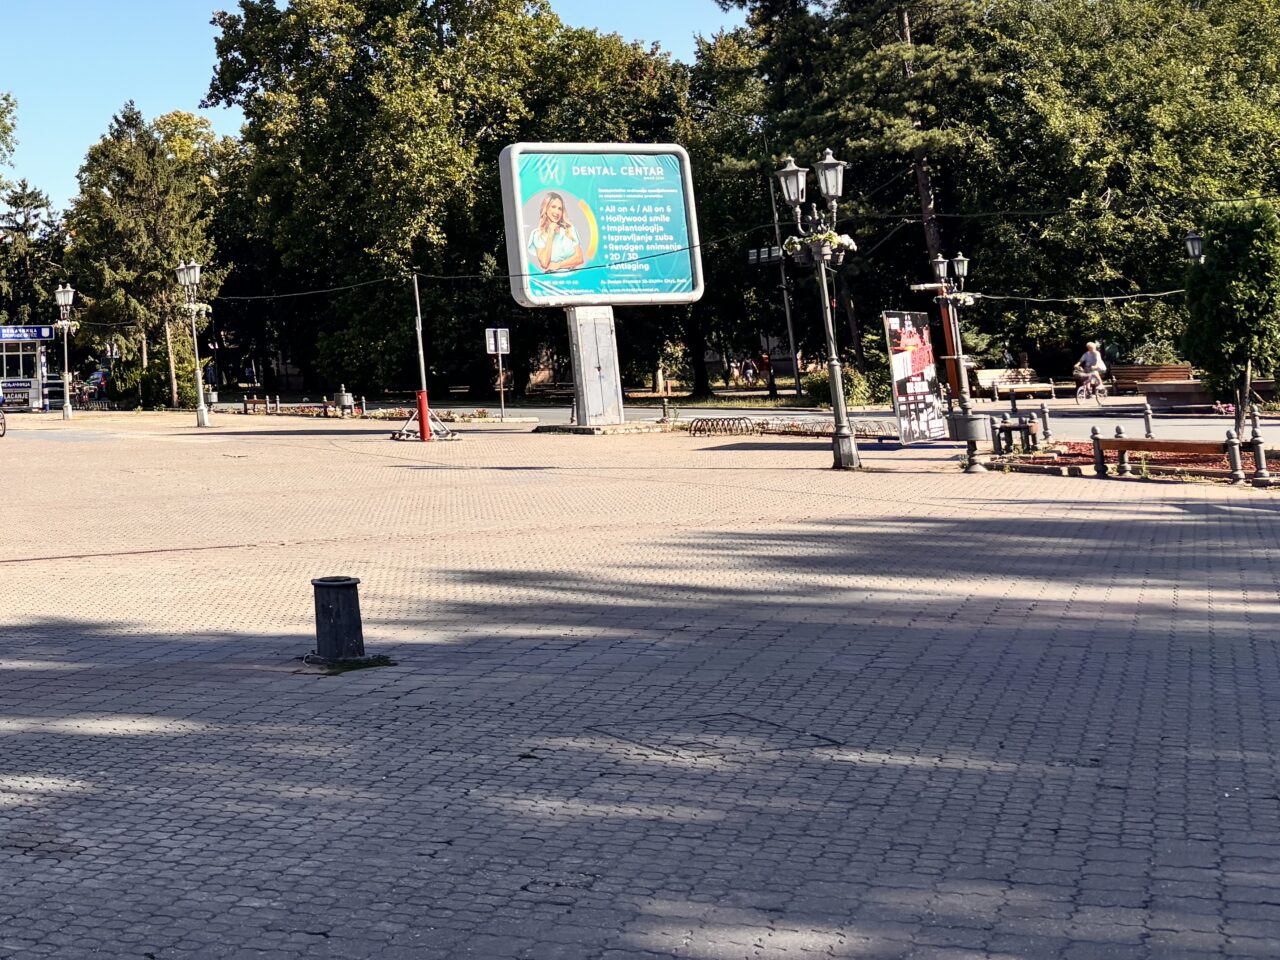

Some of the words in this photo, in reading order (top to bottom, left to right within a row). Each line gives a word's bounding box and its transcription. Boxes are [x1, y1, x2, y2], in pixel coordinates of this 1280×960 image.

[572, 166, 616, 176] DENTAL
[620, 166, 664, 176] CENTAR
[605, 205, 616, 213] All
[642, 205, 653, 213] All
[606, 215, 647, 223] Hollywood
[606, 224, 664, 233] Implantologija
[608, 234, 652, 243] Ispravljanje
[646, 243, 682, 251] snimanje
[610, 263, 650, 271] Antiaging
